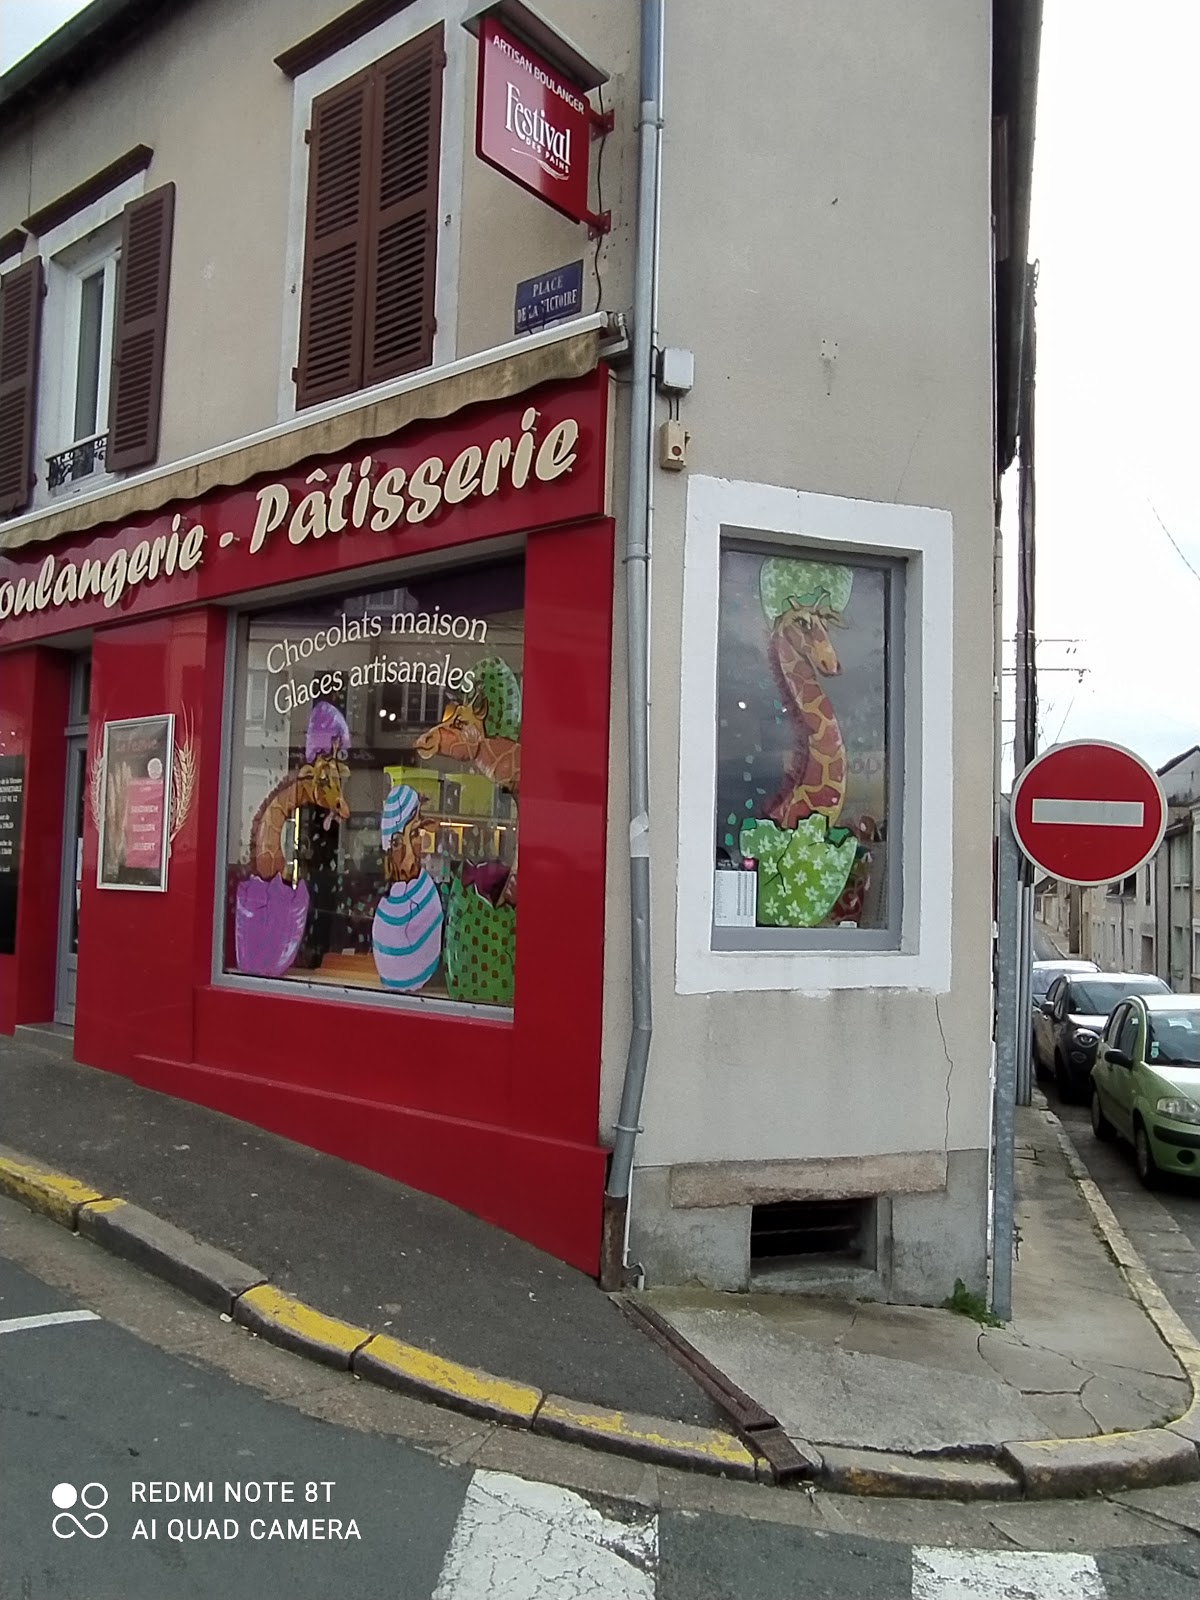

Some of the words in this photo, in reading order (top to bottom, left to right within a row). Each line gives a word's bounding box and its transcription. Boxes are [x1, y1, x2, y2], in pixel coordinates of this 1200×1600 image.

[493, 35, 532, 74] ARTISAN
[533, 66, 584, 115] BOULANGER
[505, 81, 570, 166] Festival
[525, 136, 542, 154] DES
[545, 151, 569, 174] PAINS
[517, 307, 527, 323] DE
[528, 305, 539, 319] LA
[532, 275, 564, 297] PLACE
[250, 407, 578, 554] Pâtisserie
[266, 612, 382, 674] Chocolats
[390, 605, 488, 643] maison
[274, 670, 343, 714] Glaces
[350, 654, 476, 693] artisanales
